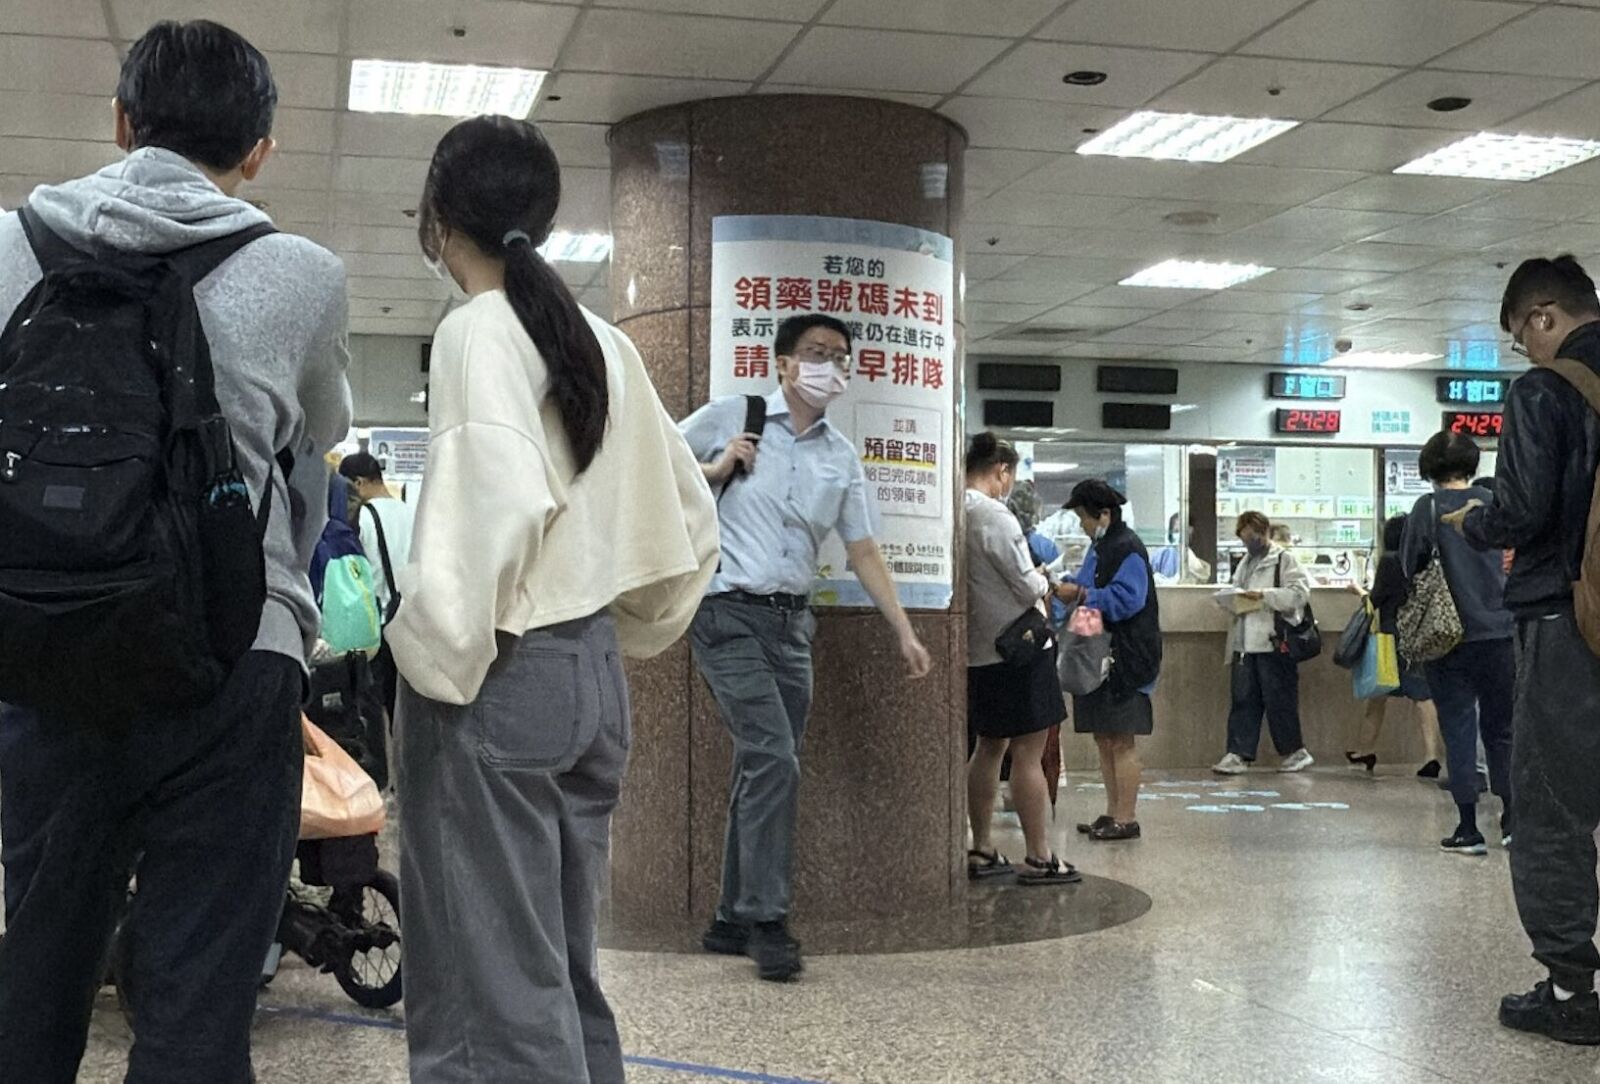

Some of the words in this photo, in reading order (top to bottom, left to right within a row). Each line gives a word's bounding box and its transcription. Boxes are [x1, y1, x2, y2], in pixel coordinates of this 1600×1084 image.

[824, 255, 884, 278] 若您的
[734, 276, 943, 325] 領藥號碼未到
[731, 317, 945, 350] 表示業仍在進行中
[734, 344, 943, 388] 請早排隊
[1286, 410, 1339, 431] 2428
[1451, 414, 1503, 434] 2429
[864, 437, 936, 464] 預留空間
